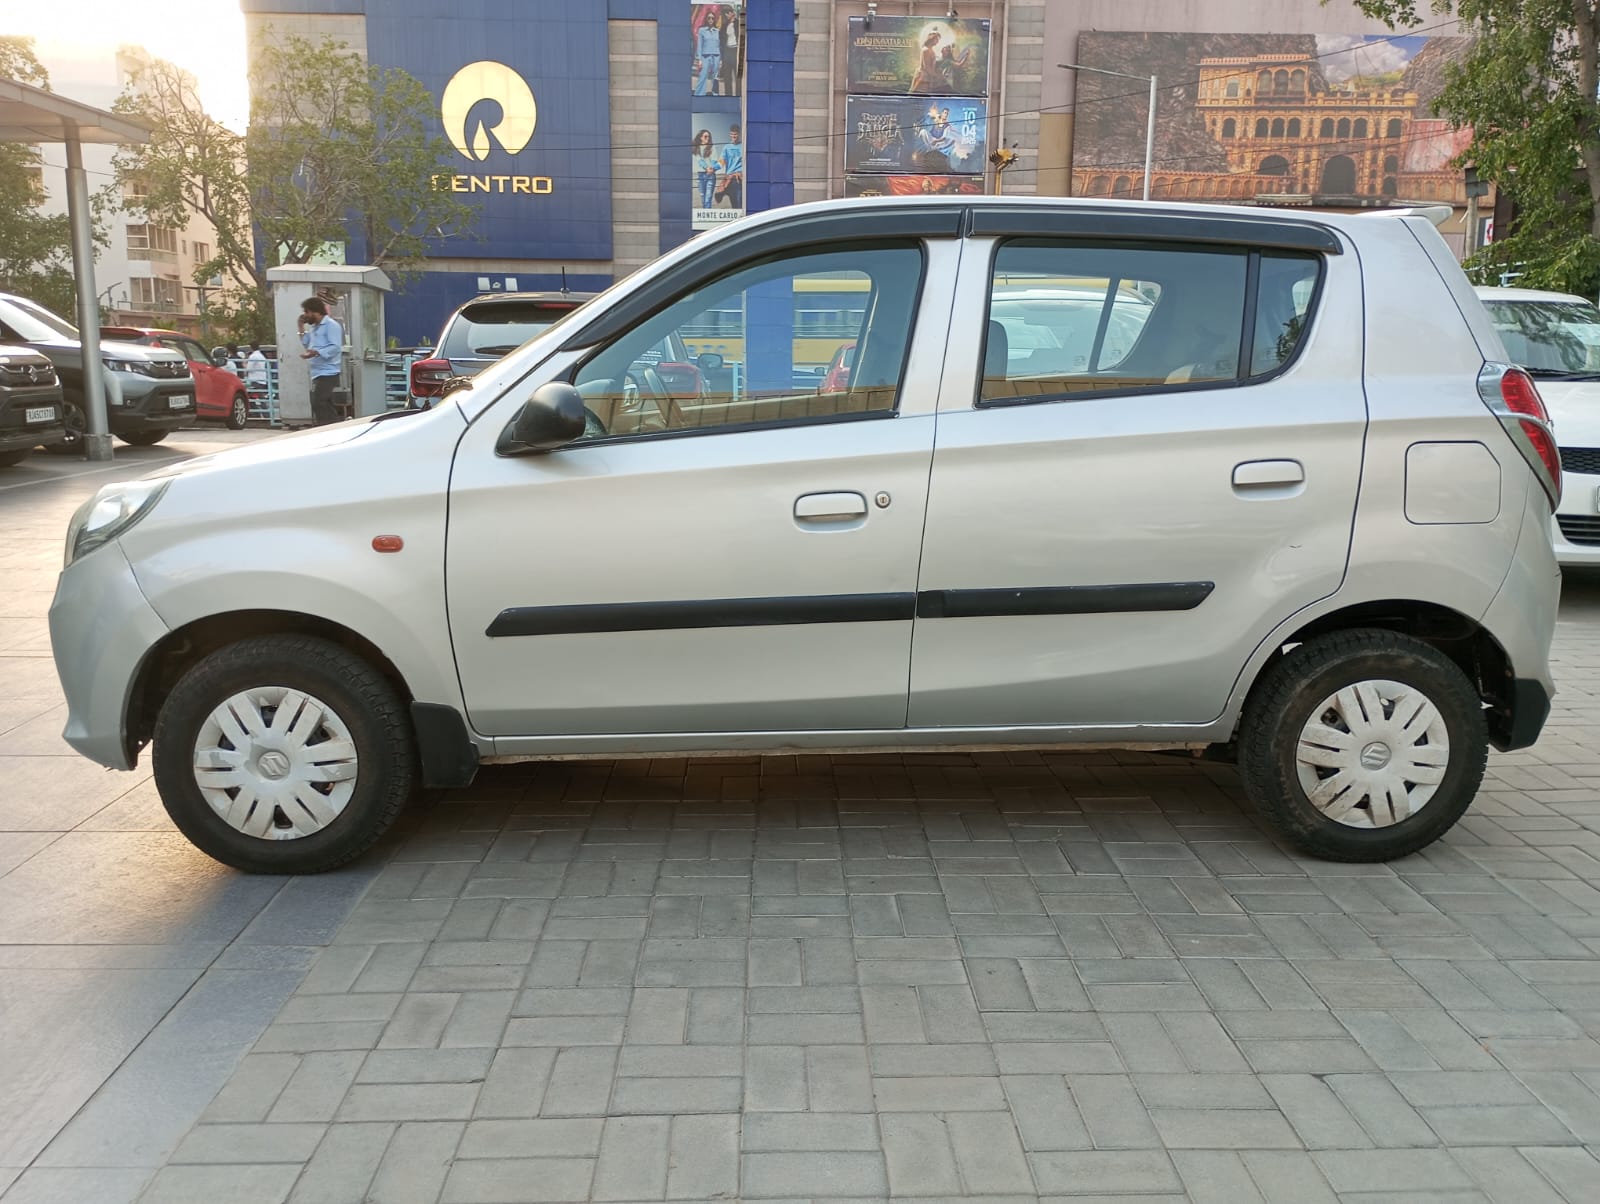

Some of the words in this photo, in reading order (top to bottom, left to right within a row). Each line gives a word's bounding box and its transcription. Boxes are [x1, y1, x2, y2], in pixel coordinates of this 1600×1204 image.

[963, 111, 976, 125] 10
[961, 124, 976, 137] 04
[697, 211, 717, 219] MONTE
